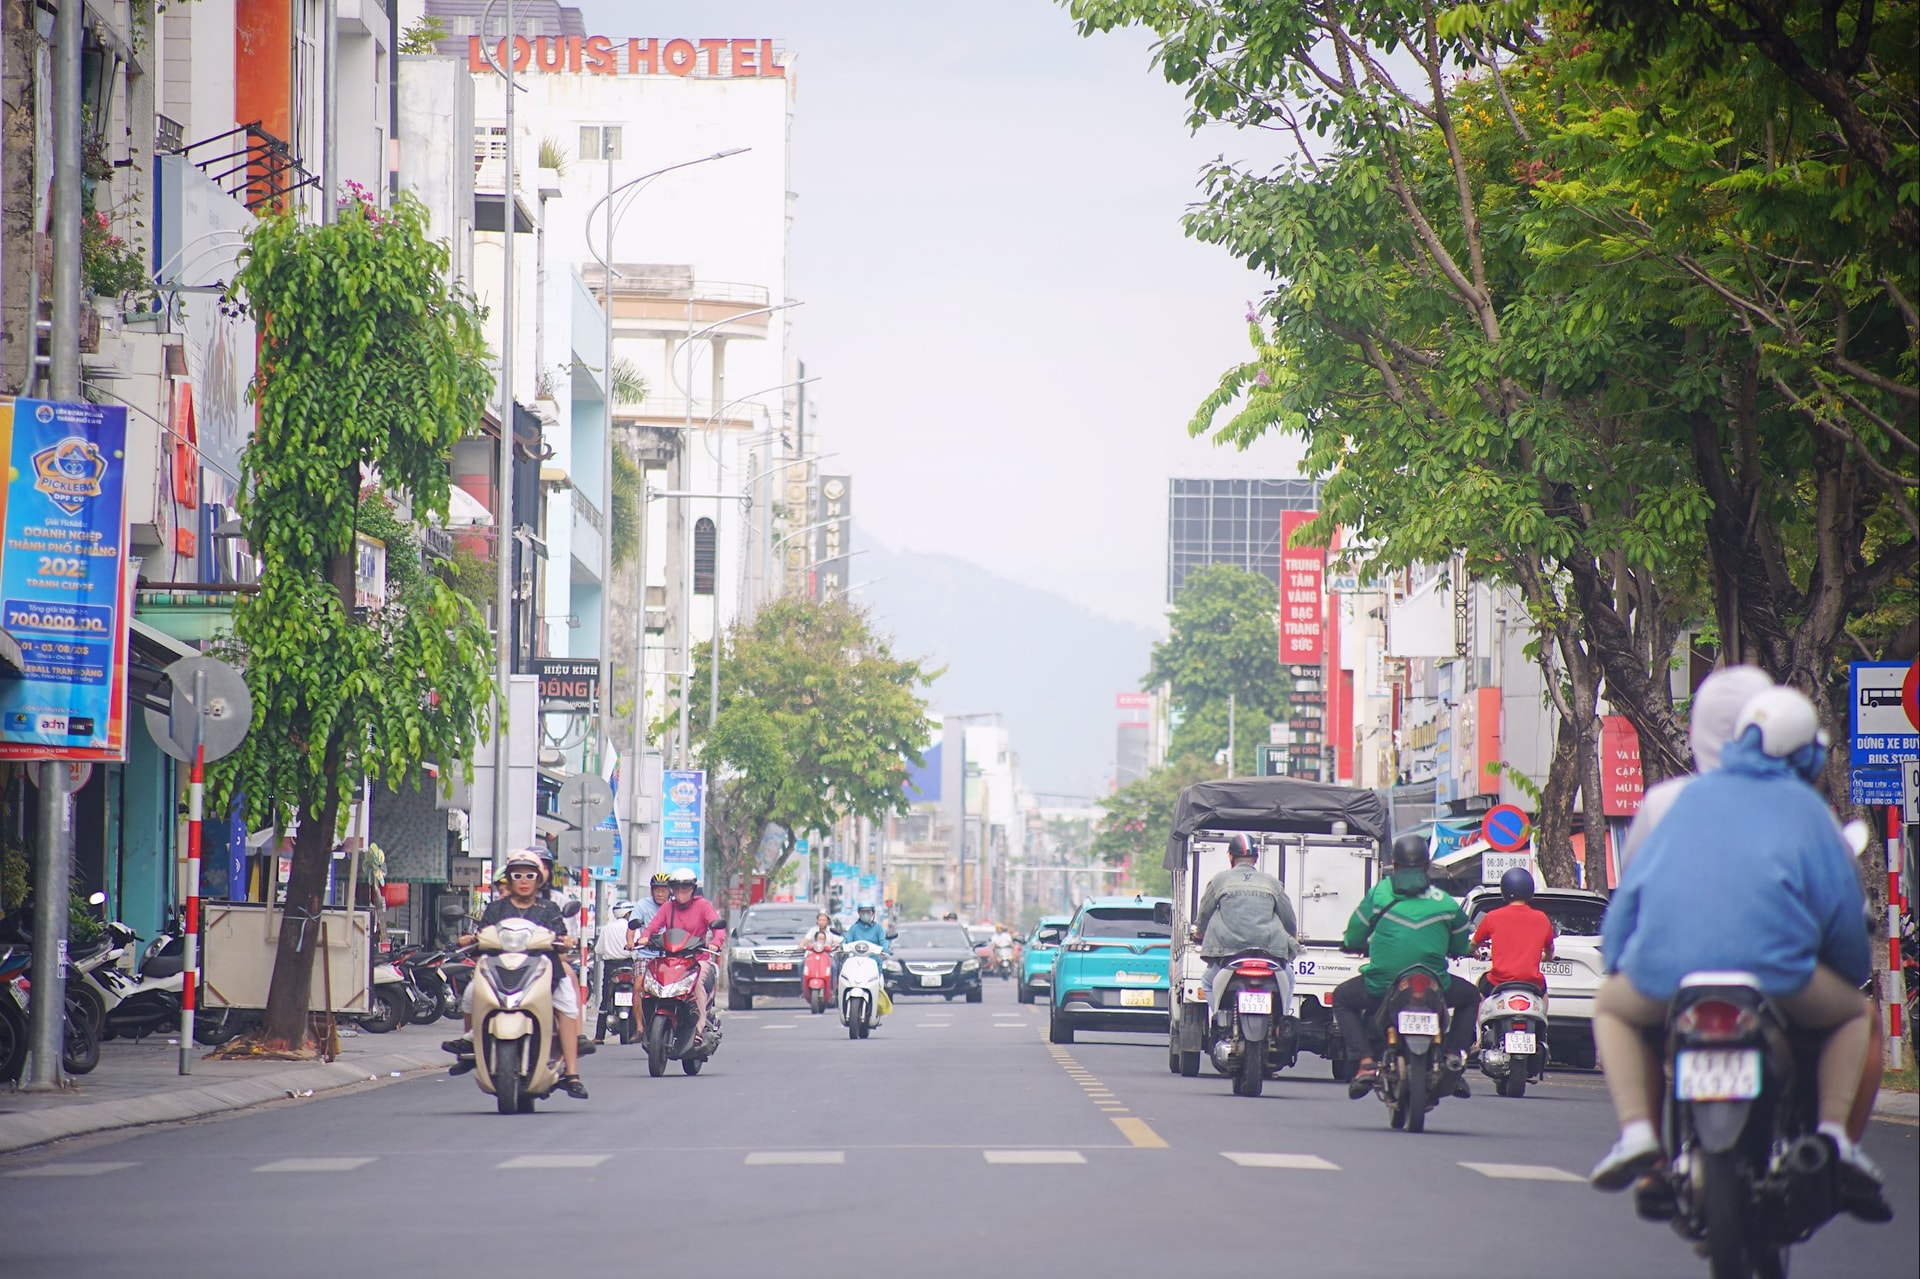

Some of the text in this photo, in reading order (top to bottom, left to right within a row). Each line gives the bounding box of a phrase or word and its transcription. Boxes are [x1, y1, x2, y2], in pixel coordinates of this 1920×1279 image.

[468, 35, 785, 77] LOUIS HOTEL
[24, 527, 67, 539] DOANH
[8, 538, 46, 551] THÀNH
[48, 541, 73, 554] PHỐ
[1285, 559, 1321, 571] TRUNG
[1291, 573, 1315, 587] TÂM
[1288, 588, 1318, 603] VÀNG
[1291, 606, 1314, 622] BẠC
[1290, 637, 1314, 651] SỨC
[543, 664, 598, 677] HIỆU KÍNH
[1887, 738, 1900, 749] XE
[1487, 858, 1504, 868] 06:30
